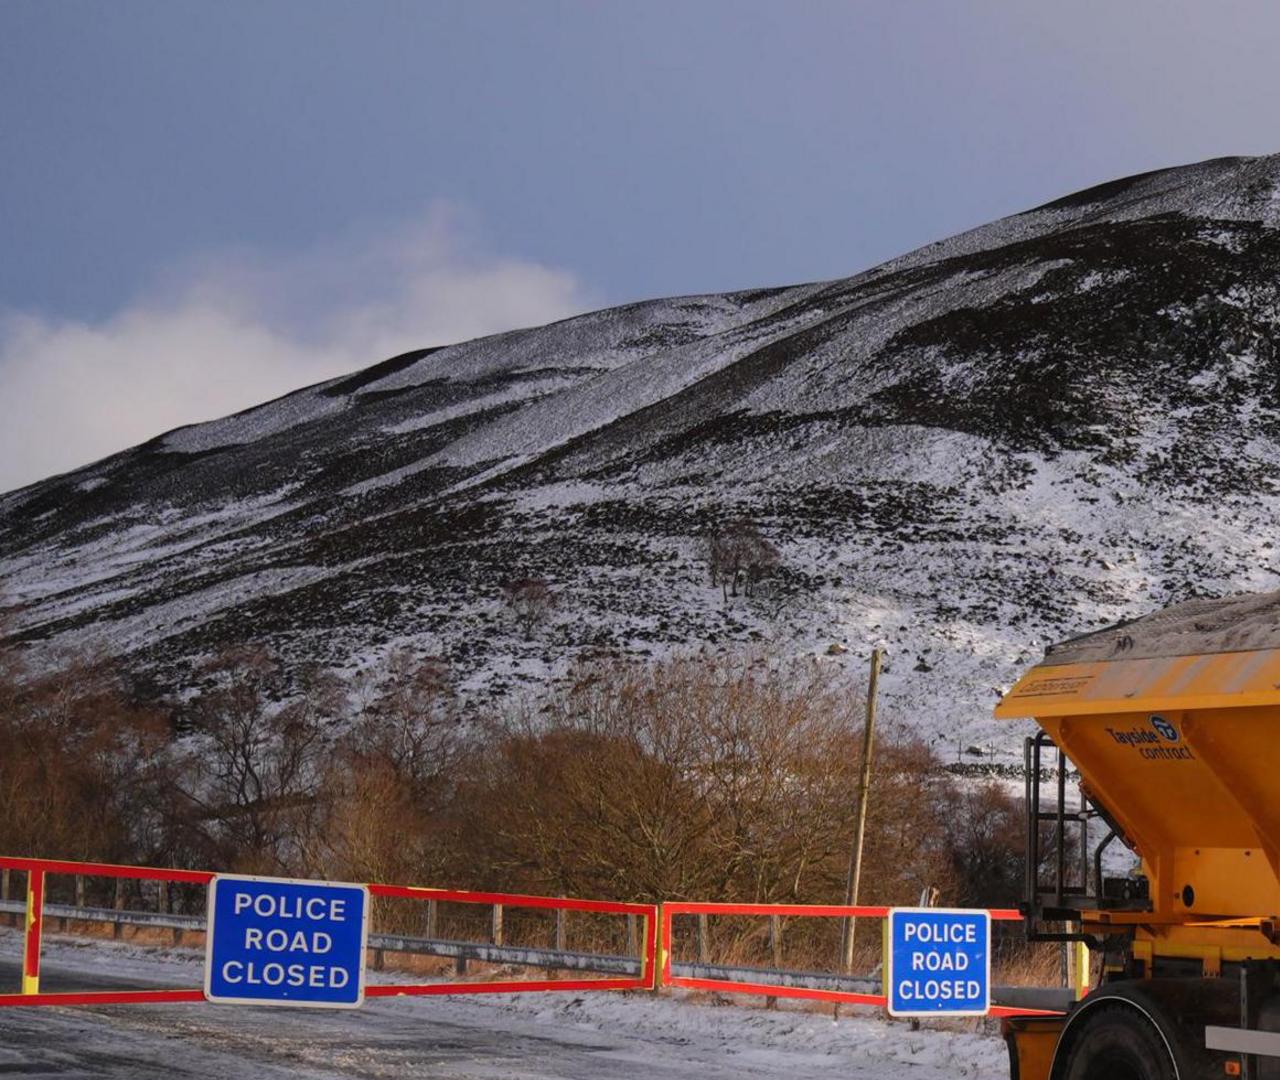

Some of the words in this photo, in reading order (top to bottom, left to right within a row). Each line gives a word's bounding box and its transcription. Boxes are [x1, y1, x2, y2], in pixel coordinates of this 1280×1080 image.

[1104, 727, 1160, 748] Tayside
[1139, 744, 1196, 760] contract
[234, 893, 346, 921] POLICE
[245, 928, 332, 954] ROAD
[904, 922, 976, 943] POLICE
[912, 951, 969, 971] ROAD
[222, 960, 349, 988] CLOSED
[899, 980, 980, 1000] CLOSED
